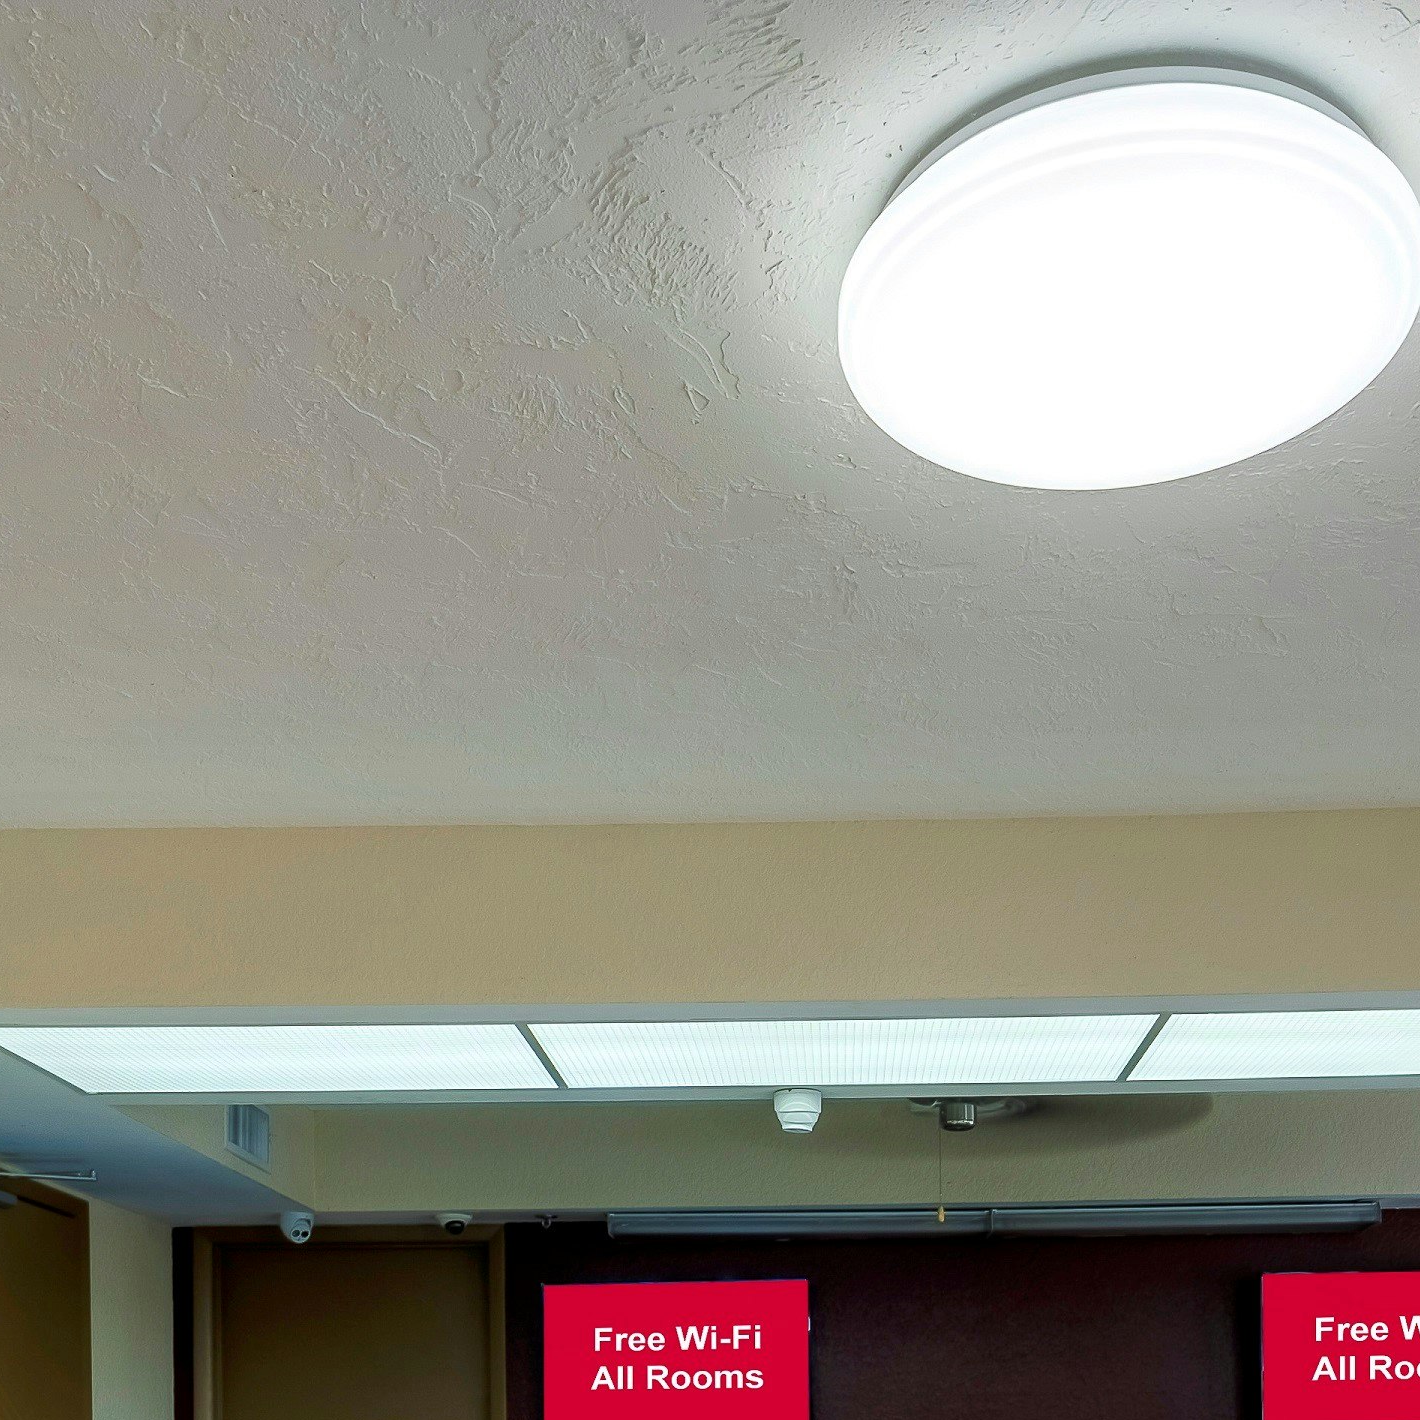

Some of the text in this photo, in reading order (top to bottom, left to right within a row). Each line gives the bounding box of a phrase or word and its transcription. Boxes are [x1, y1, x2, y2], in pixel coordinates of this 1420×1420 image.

[594, 1324, 762, 1352] Free Wi-Fi
[1315, 1316, 1389, 1342] Free
[590, 1365, 764, 1391] All Rooms
[1311, 1355, 1357, 1382] All
